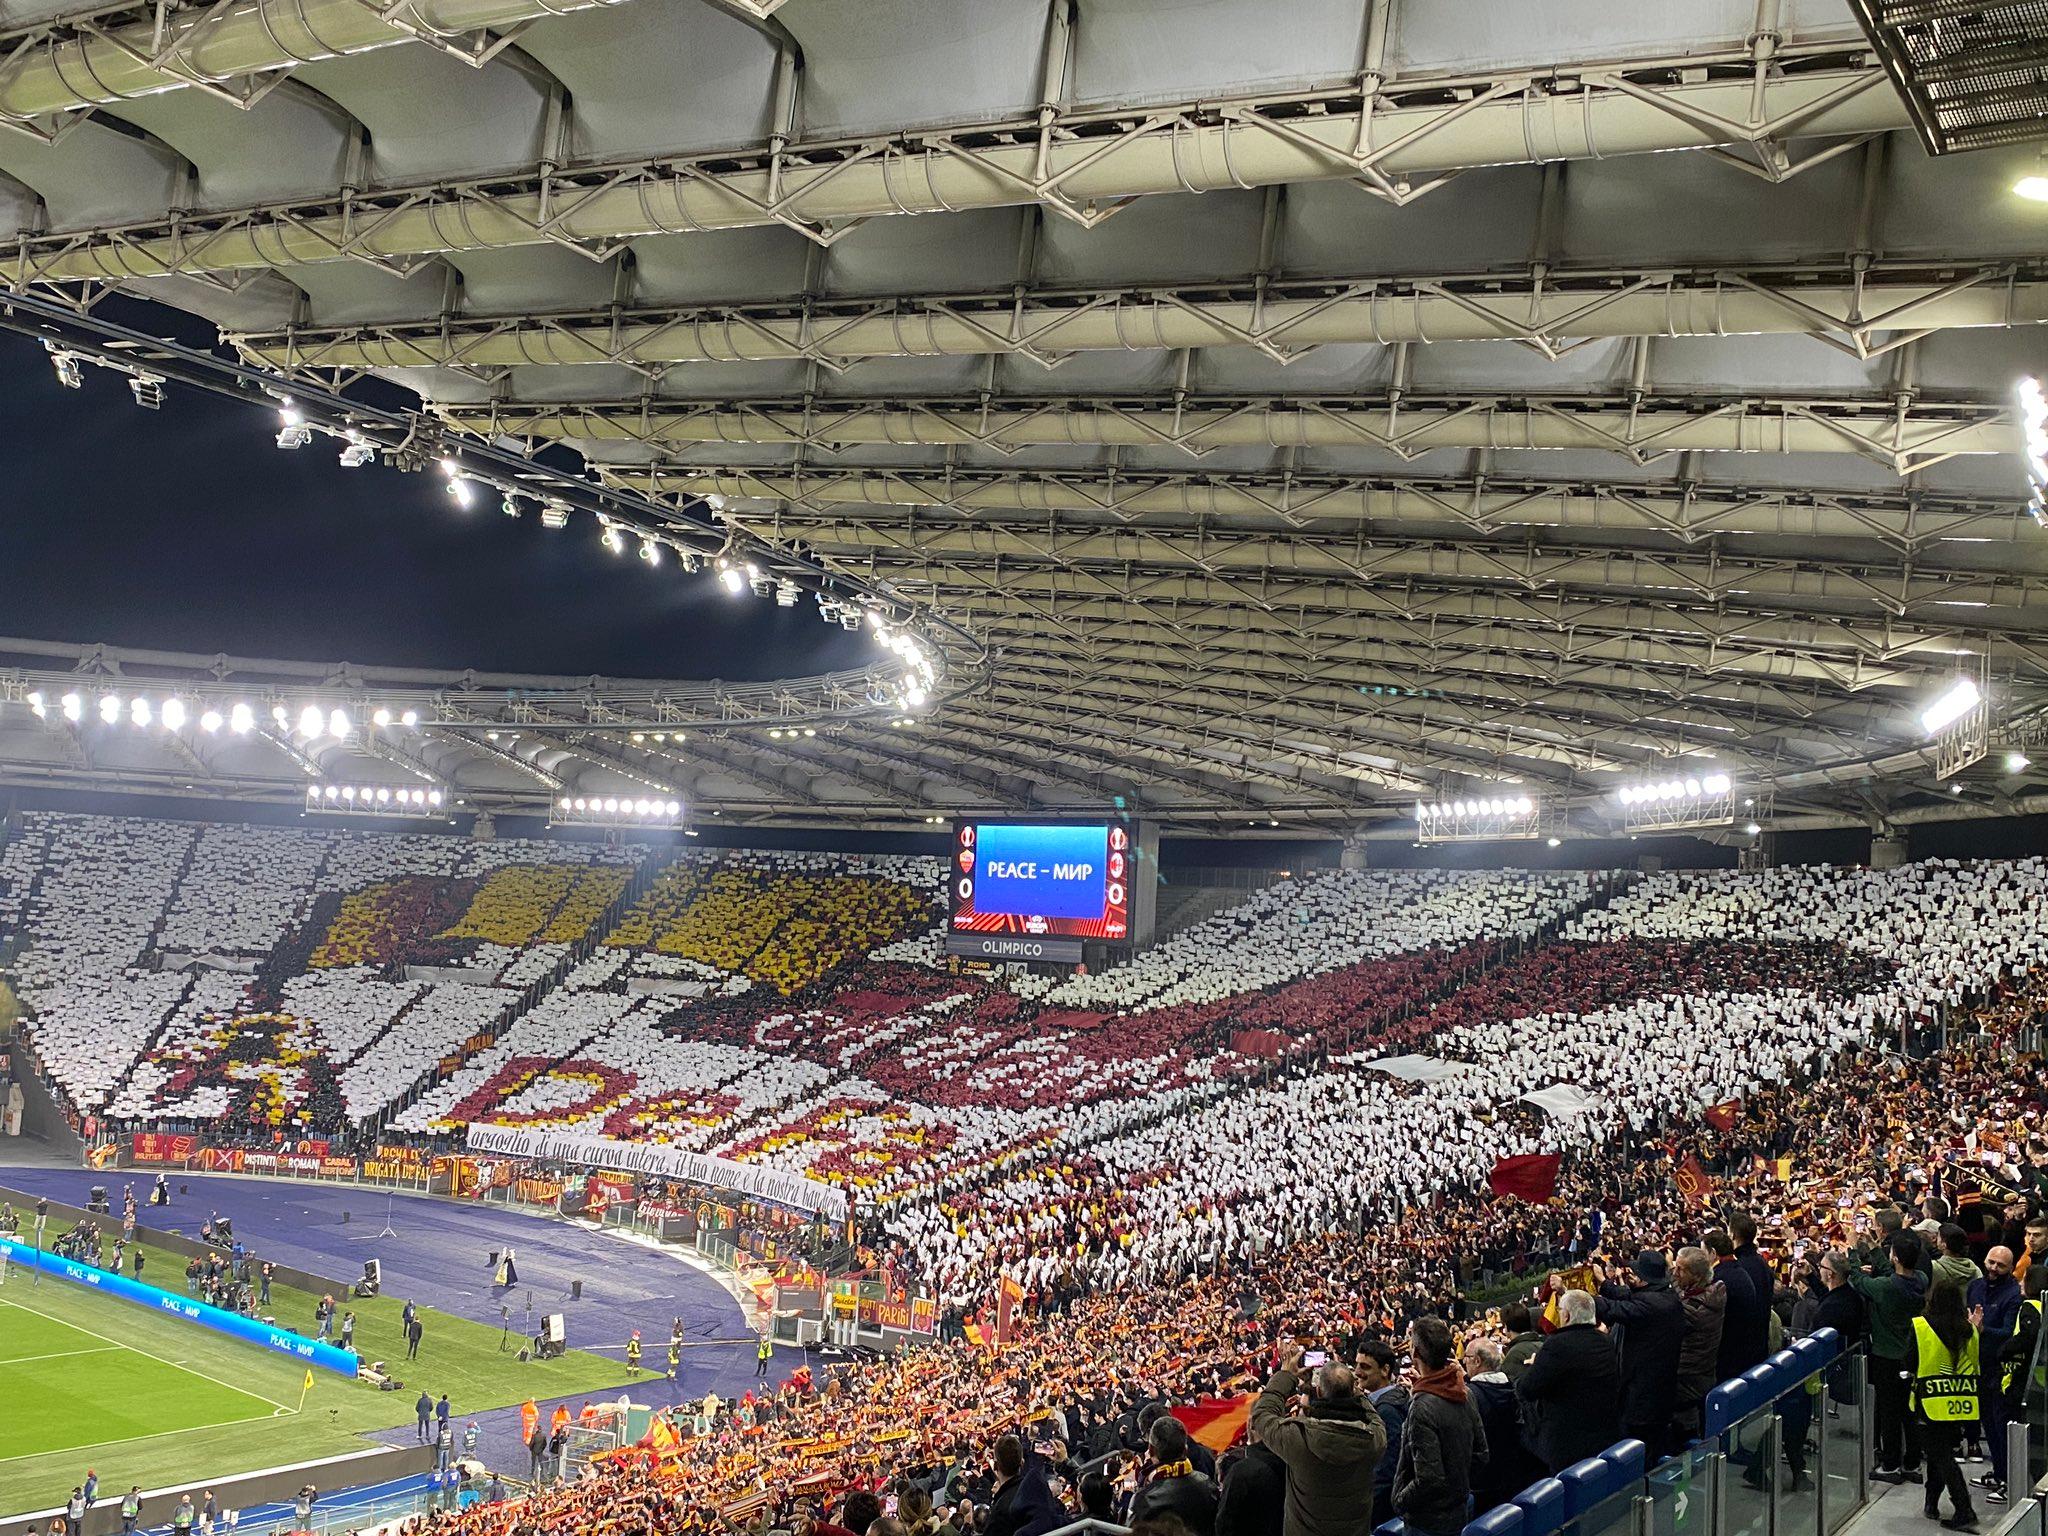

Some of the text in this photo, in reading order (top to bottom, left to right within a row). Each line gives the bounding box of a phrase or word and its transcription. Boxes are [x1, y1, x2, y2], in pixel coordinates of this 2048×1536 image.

[988, 861, 1037, 879] PEACE
[1053, 863, 1093, 881] МИР
[958, 878, 973, 899] 0
[1108, 883, 1124, 905] 0
[982, 941, 1043, 957] OLIMPICO
[244, 1155, 276, 1167] DISTINTI
[325, 1157, 351, 1167] CASAL
[471, 1128, 530, 1154] orgoglio
[534, 1134, 551, 1157] di
[553, 1141, 579, 1161] una
[582, 1143, 623, 1167] curva
[626, 1144, 669, 1175] intera,
[674, 1152, 687, 1176] il
[688, 1154, 708, 1180] tuo
[710, 1165, 741, 1188] nome
[753, 1168, 765, 1193] la
[766, 1174, 800, 1202] nostra
[364, 1162, 400, 1178] BRIGATA
[66, 1265, 83, 1279] PEACE
[161, 1297, 181, 1312] PEACE
[914, 1300, 934, 1316] AVE
[270, 1333, 292, 1349] PEACE
[1948, 1400, 1974, 1415] 209
